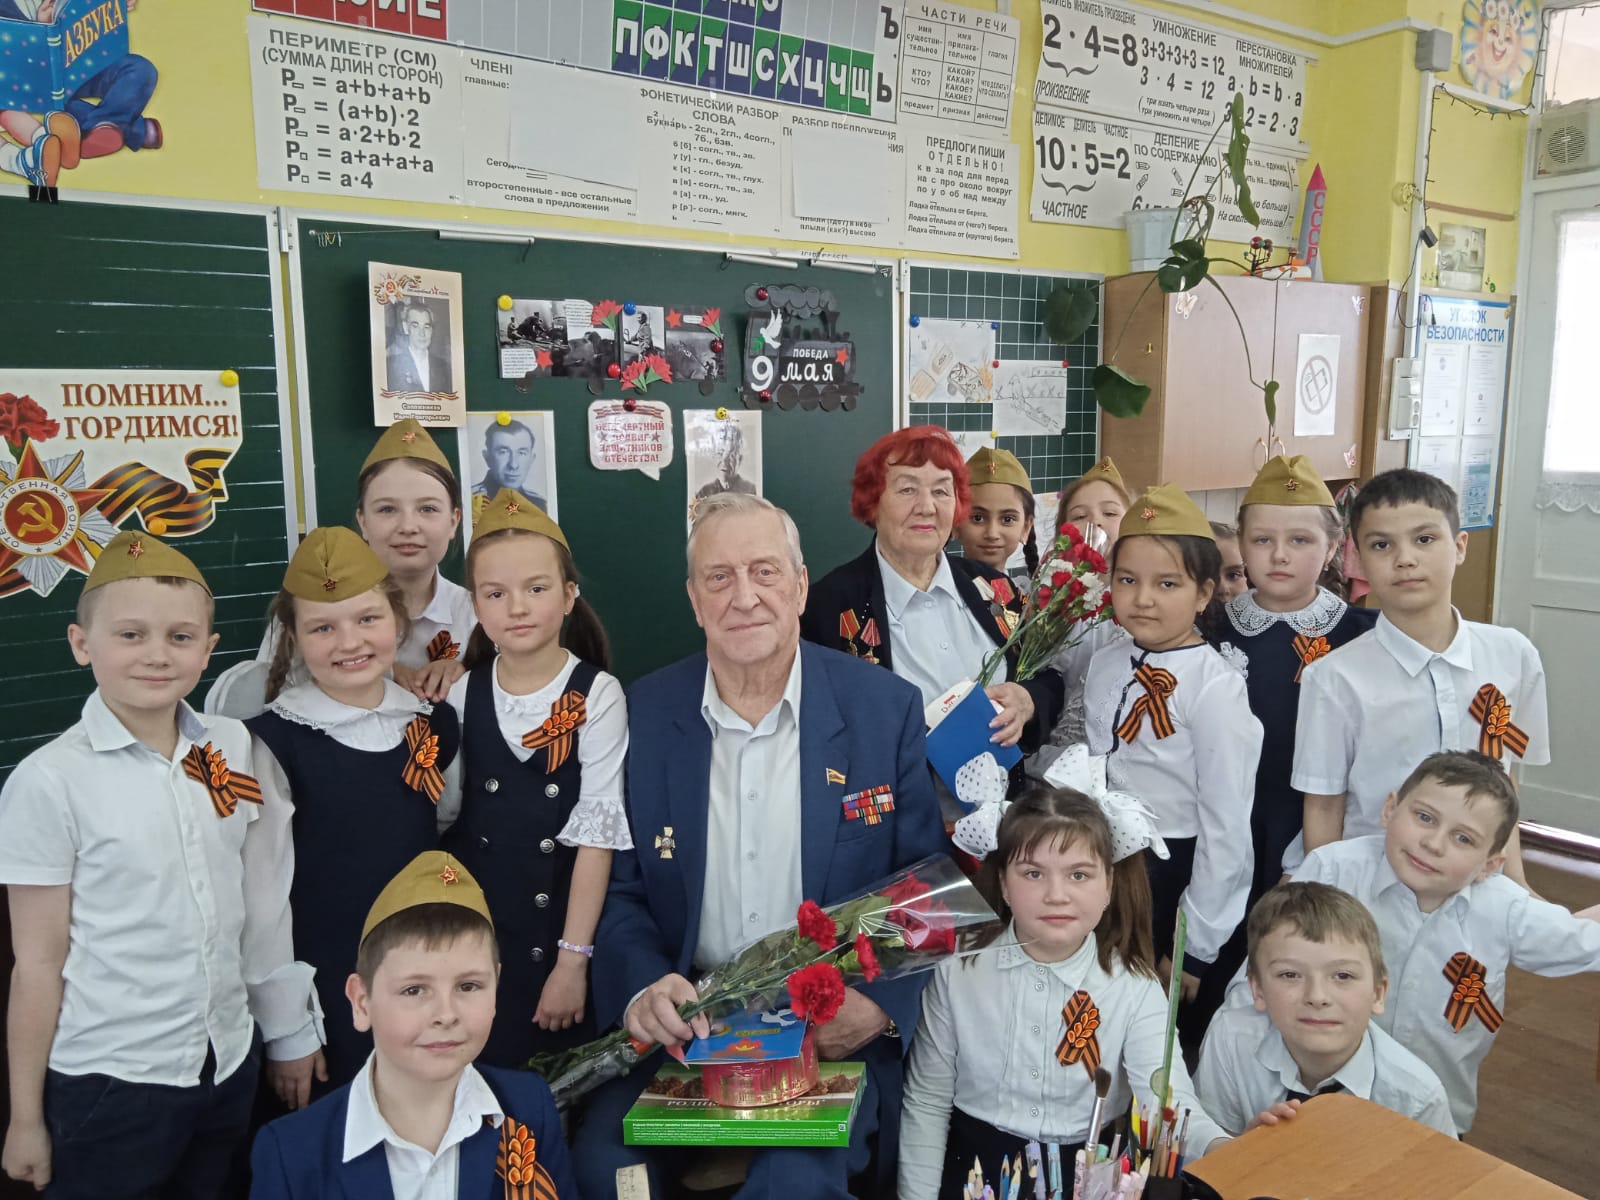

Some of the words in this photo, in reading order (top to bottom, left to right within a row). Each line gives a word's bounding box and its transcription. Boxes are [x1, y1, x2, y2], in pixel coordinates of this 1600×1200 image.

[880, 6, 899, 40] Ъ
[921, 5, 966, 24] ЧАСТИ
[976, 17, 1007, 32] РЕЧИ
[65, 0, 124, 68] АЗБУКА
[1152, 18, 1216, 47] УМНОЖЕНИЕ
[270, 29, 386, 59] ПЕРИМЕТР
[394, 48, 436, 70] (СМ)
[1236, 40, 1297, 66] ПЕРЕСТАНОВКА
[262, 47, 326, 69] (СУММА
[331, 57, 373, 75] ДЛИН
[378, 64, 443, 88] СТОРОН)
[471, 58, 513, 75] ЧЛЕН
[912, 68, 931, 77] КТО?
[947, 66, 975, 77] КАКОЙ?
[1213, 55, 1225, 75] 12
[1240, 55, 1293, 79] МНОЖИТЕЛЕЙ
[465, 75, 510, 89] главные:
[877, 72, 892, 102] Ь
[912, 77, 930, 86] ЧТО?
[946, 84, 973, 93] КАКОЕ?
[947, 75, 974, 84] КАКАЯ?
[945, 92, 972, 102] КАКИЕ?
[1035, 80, 1090, 104] ПРОИЗВЕДЕНИЕ
[1201, 80, 1215, 100] 12
[640, 88, 734, 113] ФОНЕТИЧЕСКИЙ
[736, 105, 779, 120] РАЗБОР
[904, 101, 934, 110] предмет
[693, 110, 736, 126] СЛОВА
[1035, 111, 1065, 128] ДЕЛИМОЕ
[1073, 118, 1096, 133] ДЕЛИТЕЛЬ
[1104, 124, 1128, 139] ЧАСТНОЕ
[926, 136, 976, 154] ПРЕДЛОГИ
[978, 145, 1005, 159] ПИШИ
[1154, 133, 1200, 150] ДЕЛЕНИЕ
[1134, 144, 1148, 156] ПО
[1151, 148, 1217, 168] СОДЕРЖАНИЮ
[467, 179, 552, 196] второстепенные
[580, 193, 632, 205] остальные
[960, 182, 982, 191] около
[987, 185, 1012, 197] вокруг
[504, 193, 534, 204] слова
[545, 199, 609, 212] предложении
[982, 196, 1007, 206] между
[1042, 200, 1088, 219] ЧАСТНОЕ
[1262, 200, 1287, 212] больше
[1261, 218, 1284, 227] еньше
[1427, 325, 1504, 342] БЕЗОПАСНОСТИ
[793, 349, 828, 360] ПОБЕДА
[751, 356, 773, 392] 9
[61, 383, 227, 407] ПОМНИМ...
[64, 415, 238, 443] ГОРДИМСЯ!
[605, 455, 658, 463] ОТЕЧЕСТВА!
[54, 505, 76, 546] ВОЙНА
